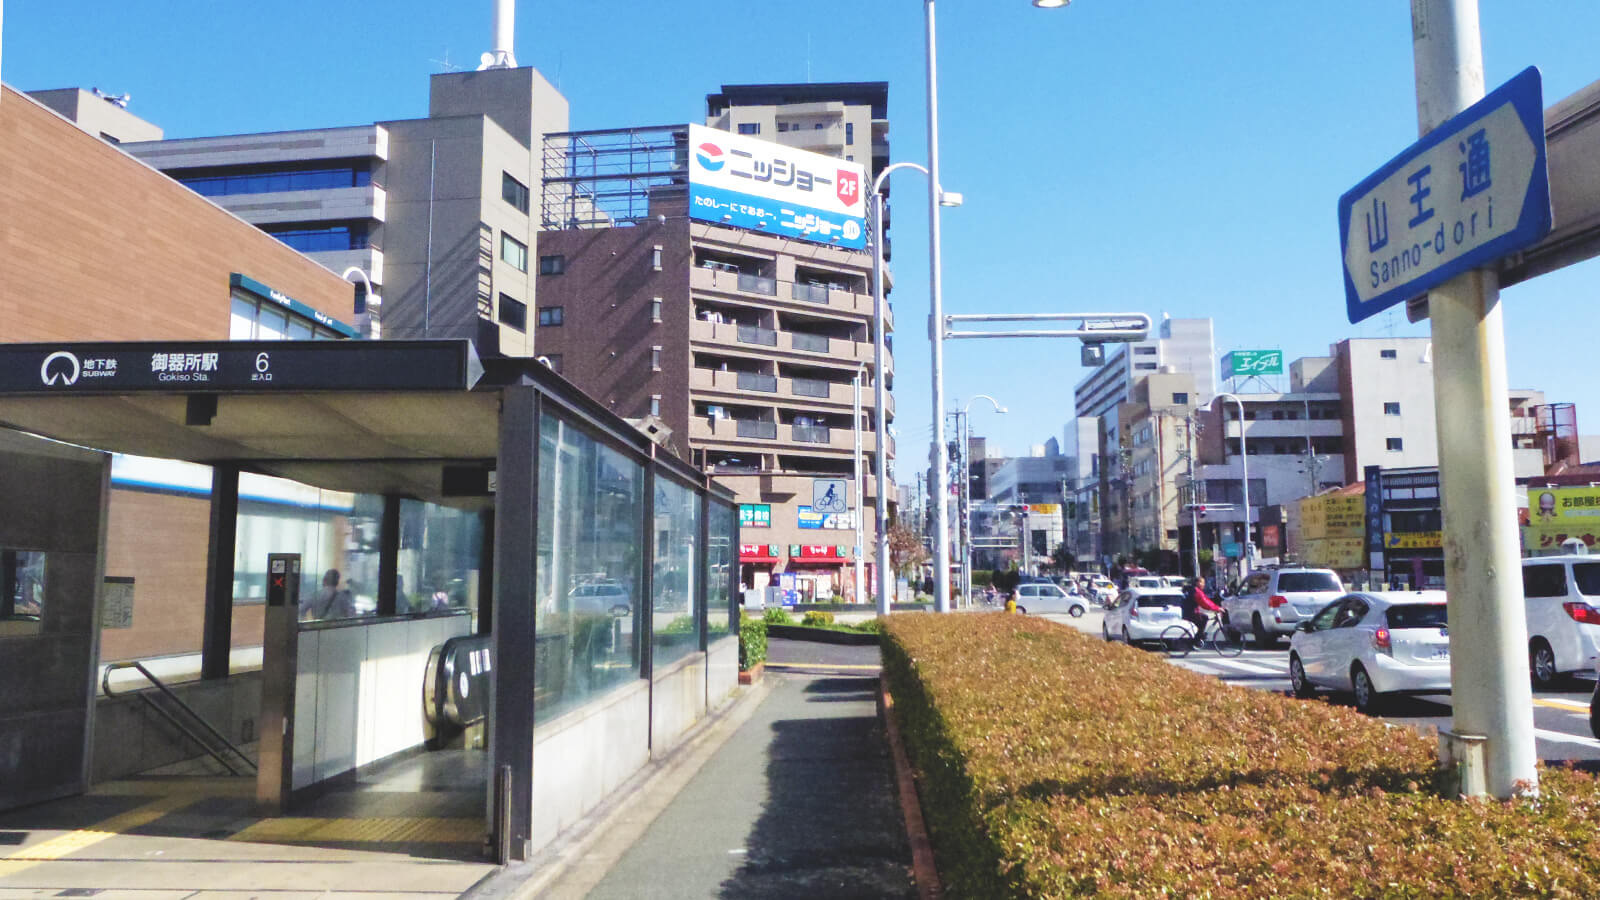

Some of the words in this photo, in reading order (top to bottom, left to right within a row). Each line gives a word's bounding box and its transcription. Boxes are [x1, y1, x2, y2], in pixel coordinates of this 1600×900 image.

[729, 148, 833, 192] ニッショー
[839, 178, 857, 197] 2F
[1366, 128, 1492, 254] 山王通
[83, 358, 118, 370] 地下鉄
[151, 352, 219, 372] 御器所駅
[255, 352, 270, 373] 6
[82, 370, 117, 378] SUBWAY
[158, 372, 191, 382] Gokiso
[250, 373, 273, 382] 出入口
